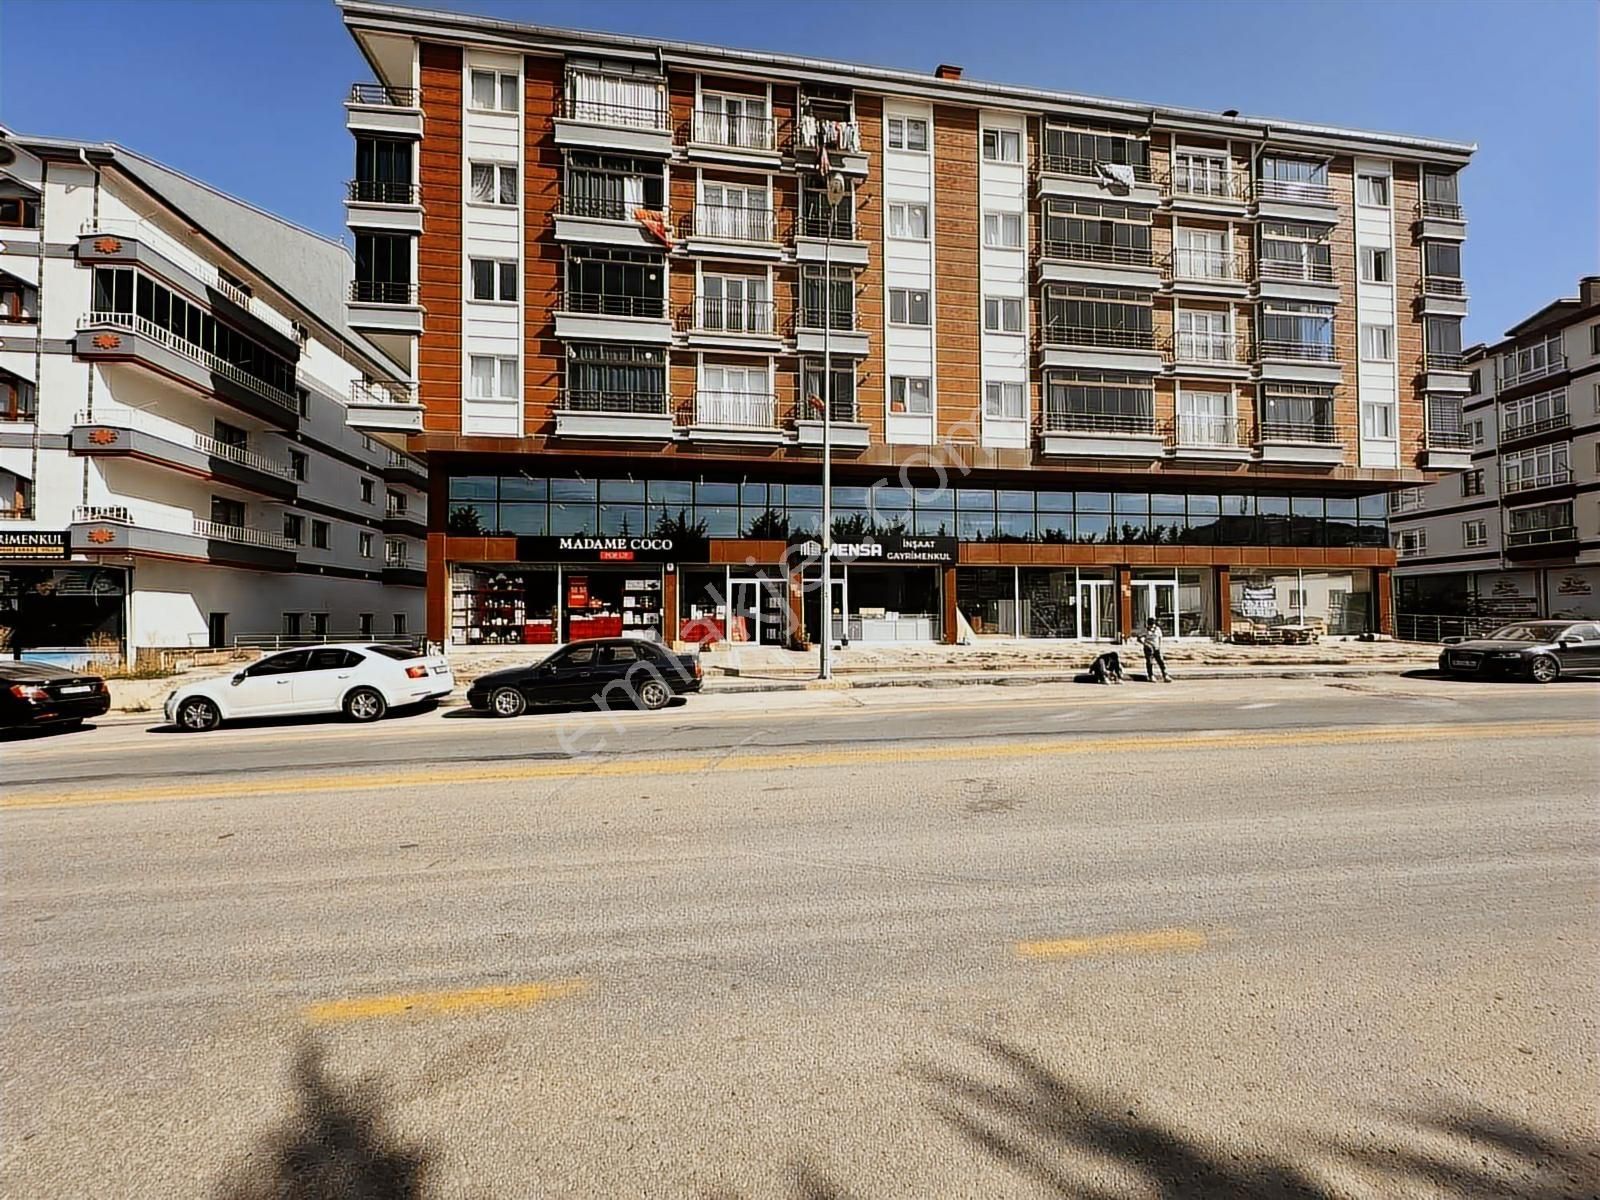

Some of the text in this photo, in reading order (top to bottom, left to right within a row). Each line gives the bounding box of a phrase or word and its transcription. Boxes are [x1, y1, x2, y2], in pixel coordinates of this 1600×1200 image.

[559, 538, 673, 550] MADAME COCO
[903, 538, 935, 550] İNŞAAT
[887, 551, 951, 561] GAYRİMENKUL
